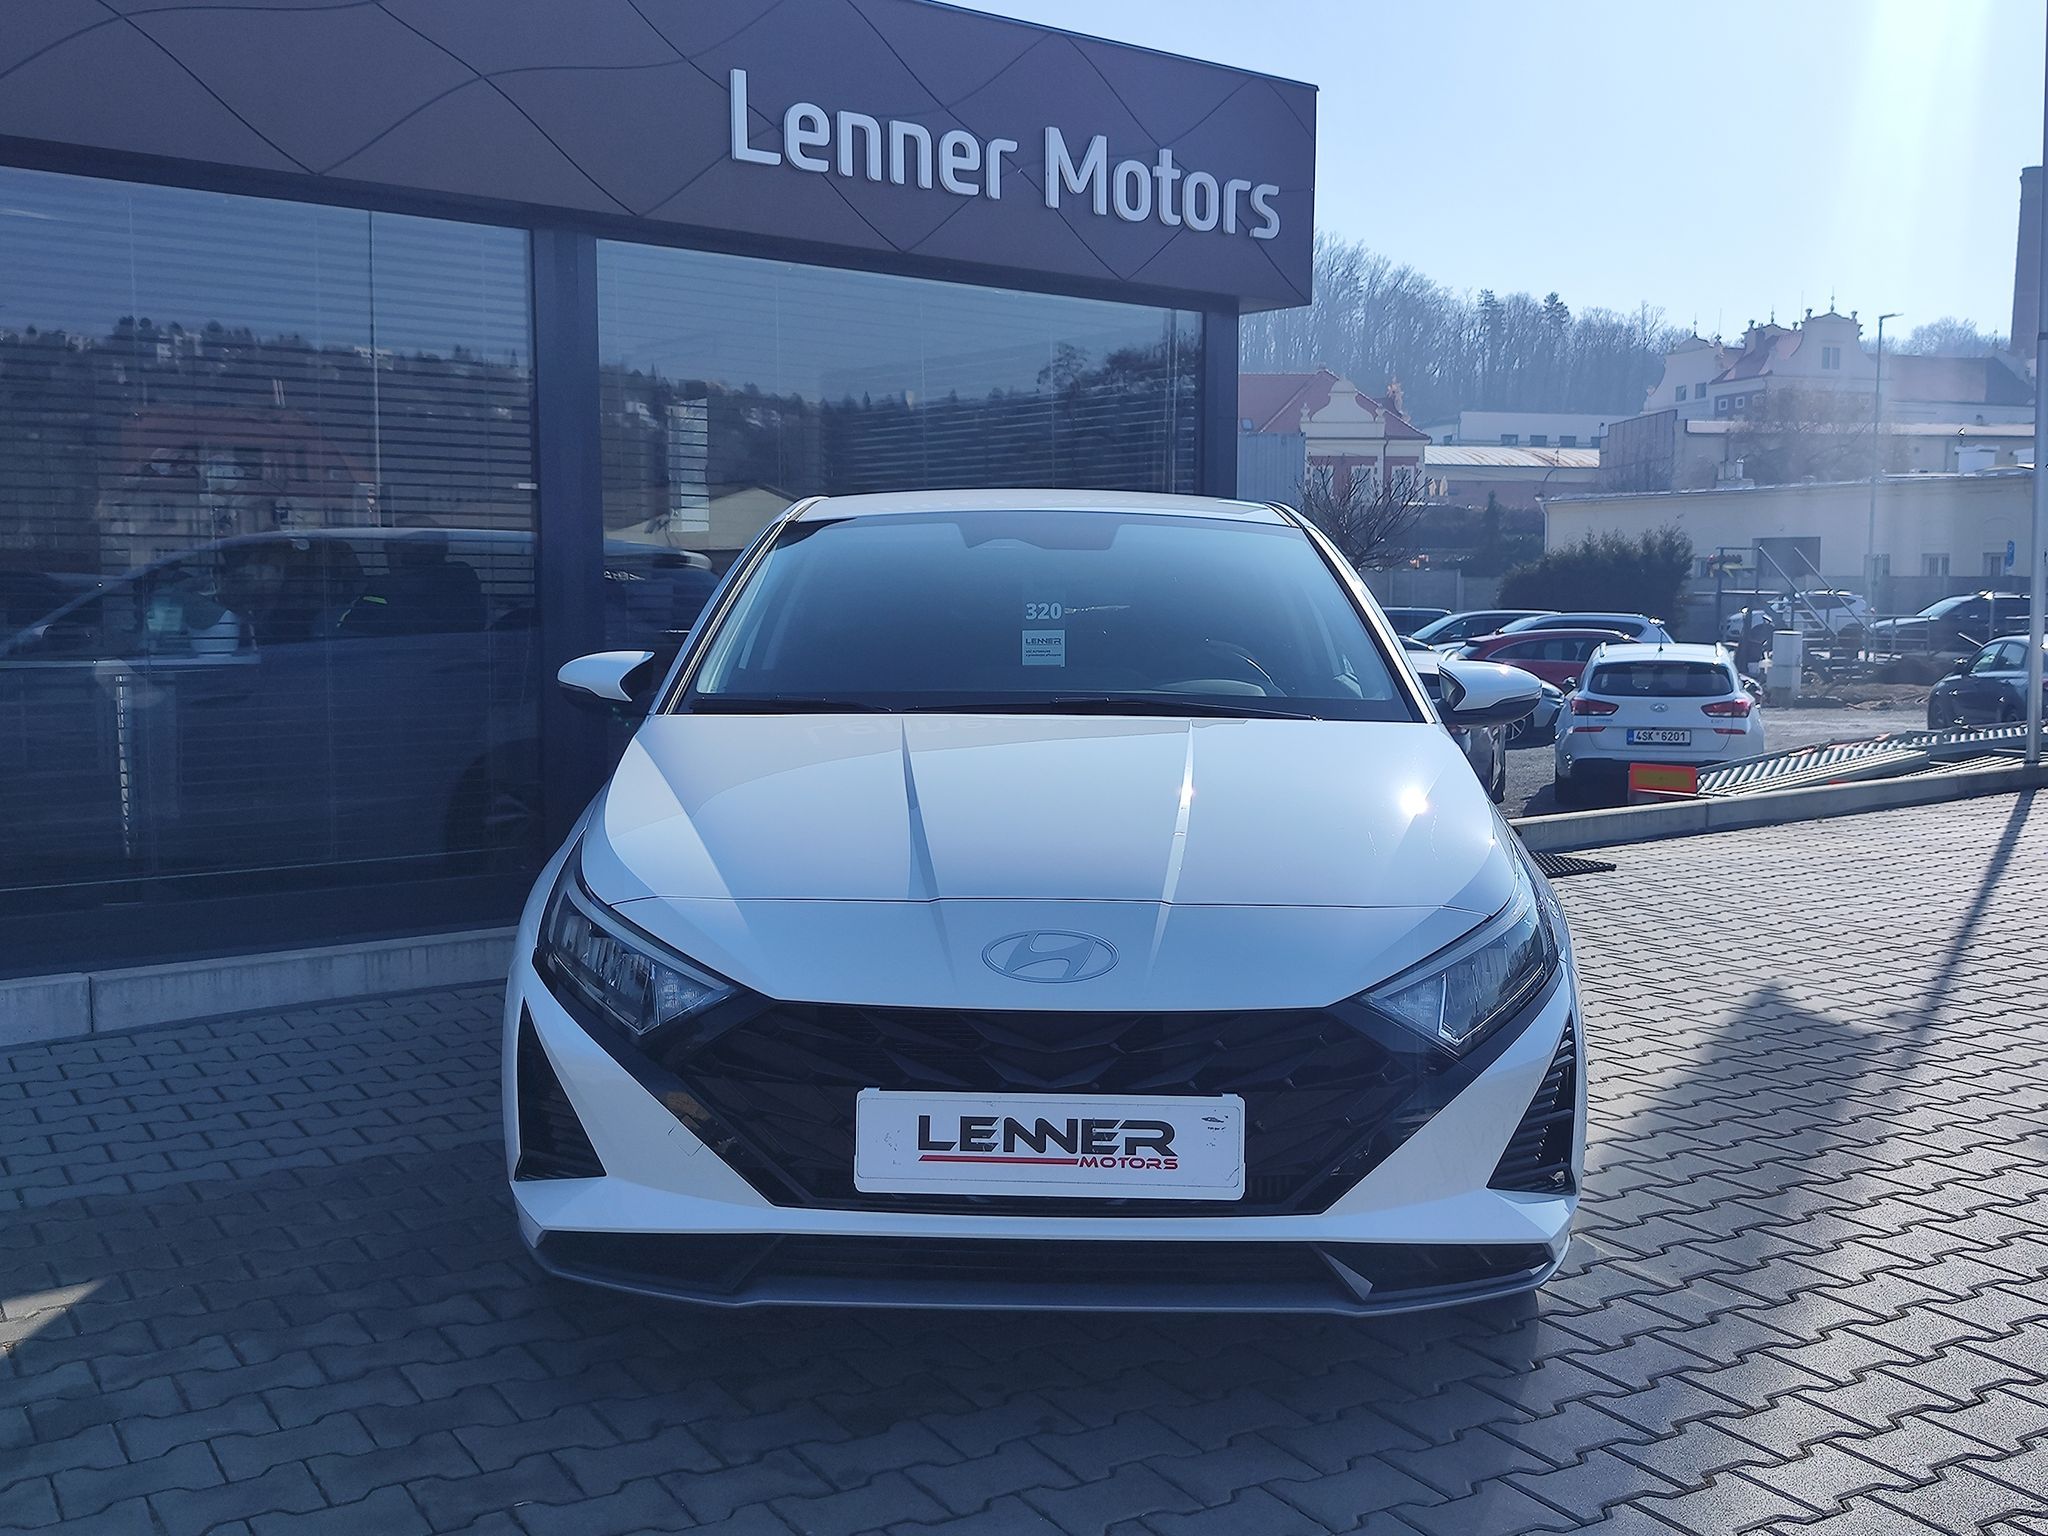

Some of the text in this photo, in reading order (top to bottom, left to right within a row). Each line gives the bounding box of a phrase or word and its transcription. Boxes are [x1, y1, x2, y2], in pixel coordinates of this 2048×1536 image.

[729, 68, 1280, 240] Lenner Motors
[1025, 602, 1062, 620] 320
[1025, 637, 1062, 646] LENNER
[1661, 731, 1686, 742] 6201
[918, 1114, 1178, 1156] LENNER
[1078, 1155, 1179, 1170] MOTORS
